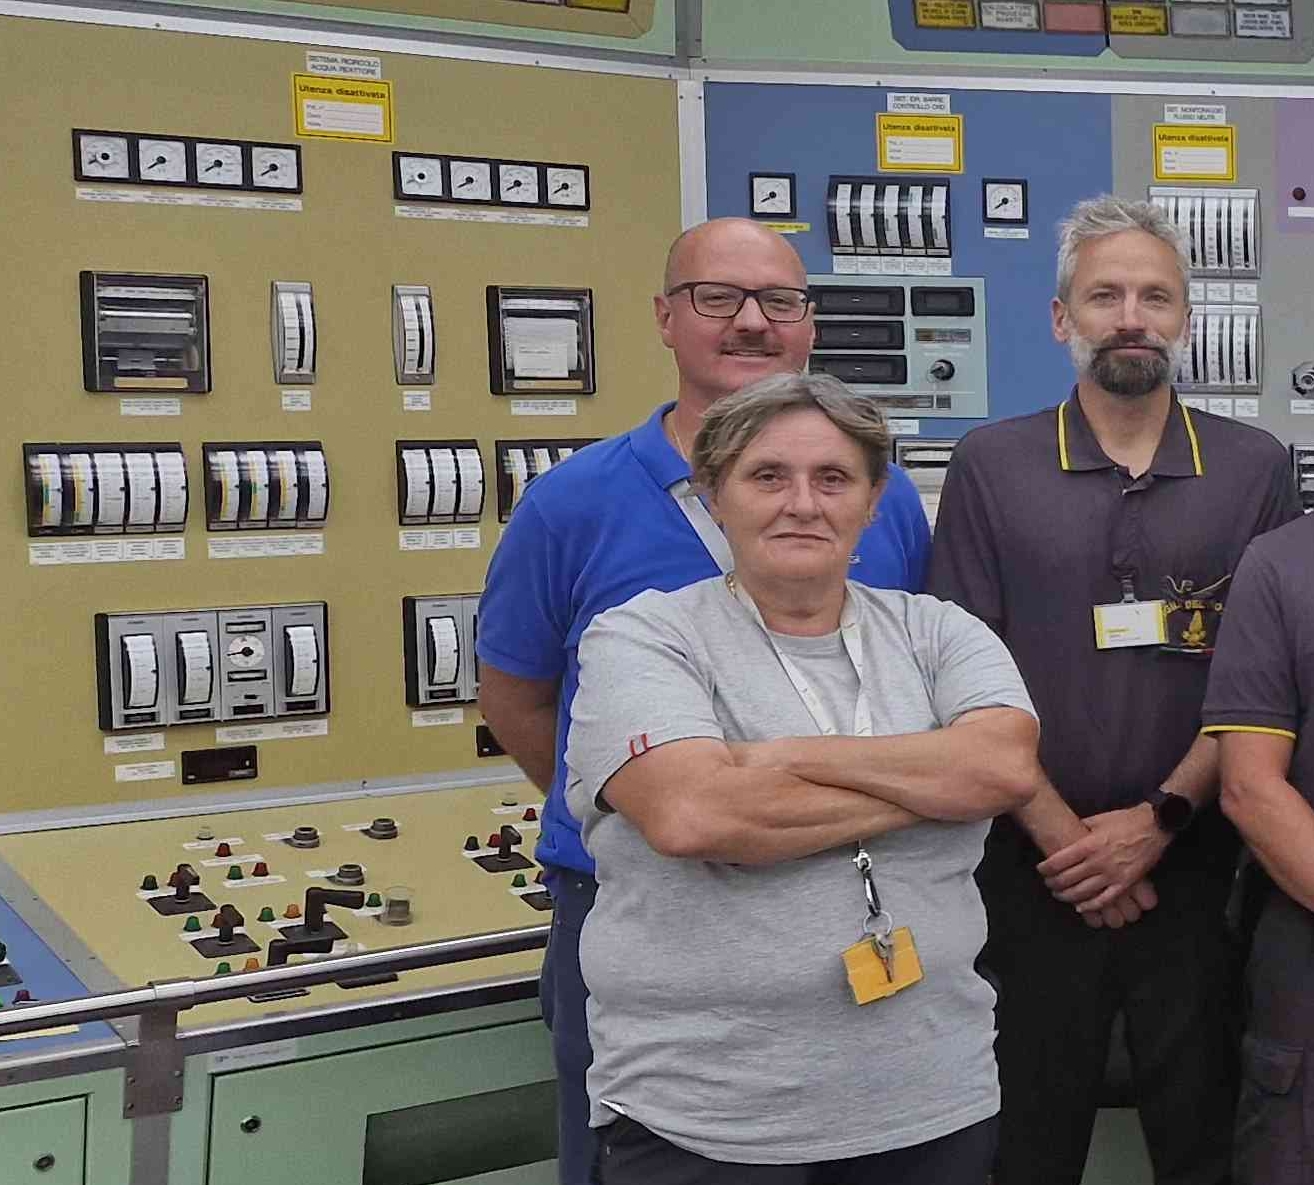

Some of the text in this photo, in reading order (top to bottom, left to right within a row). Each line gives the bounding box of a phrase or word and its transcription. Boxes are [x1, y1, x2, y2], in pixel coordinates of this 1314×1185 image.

[299, 84, 386, 99] Utenza disattivata
[883, 123, 956, 132] Utenza disattivata
[1158, 133, 1229, 142] Utenza disattivata
